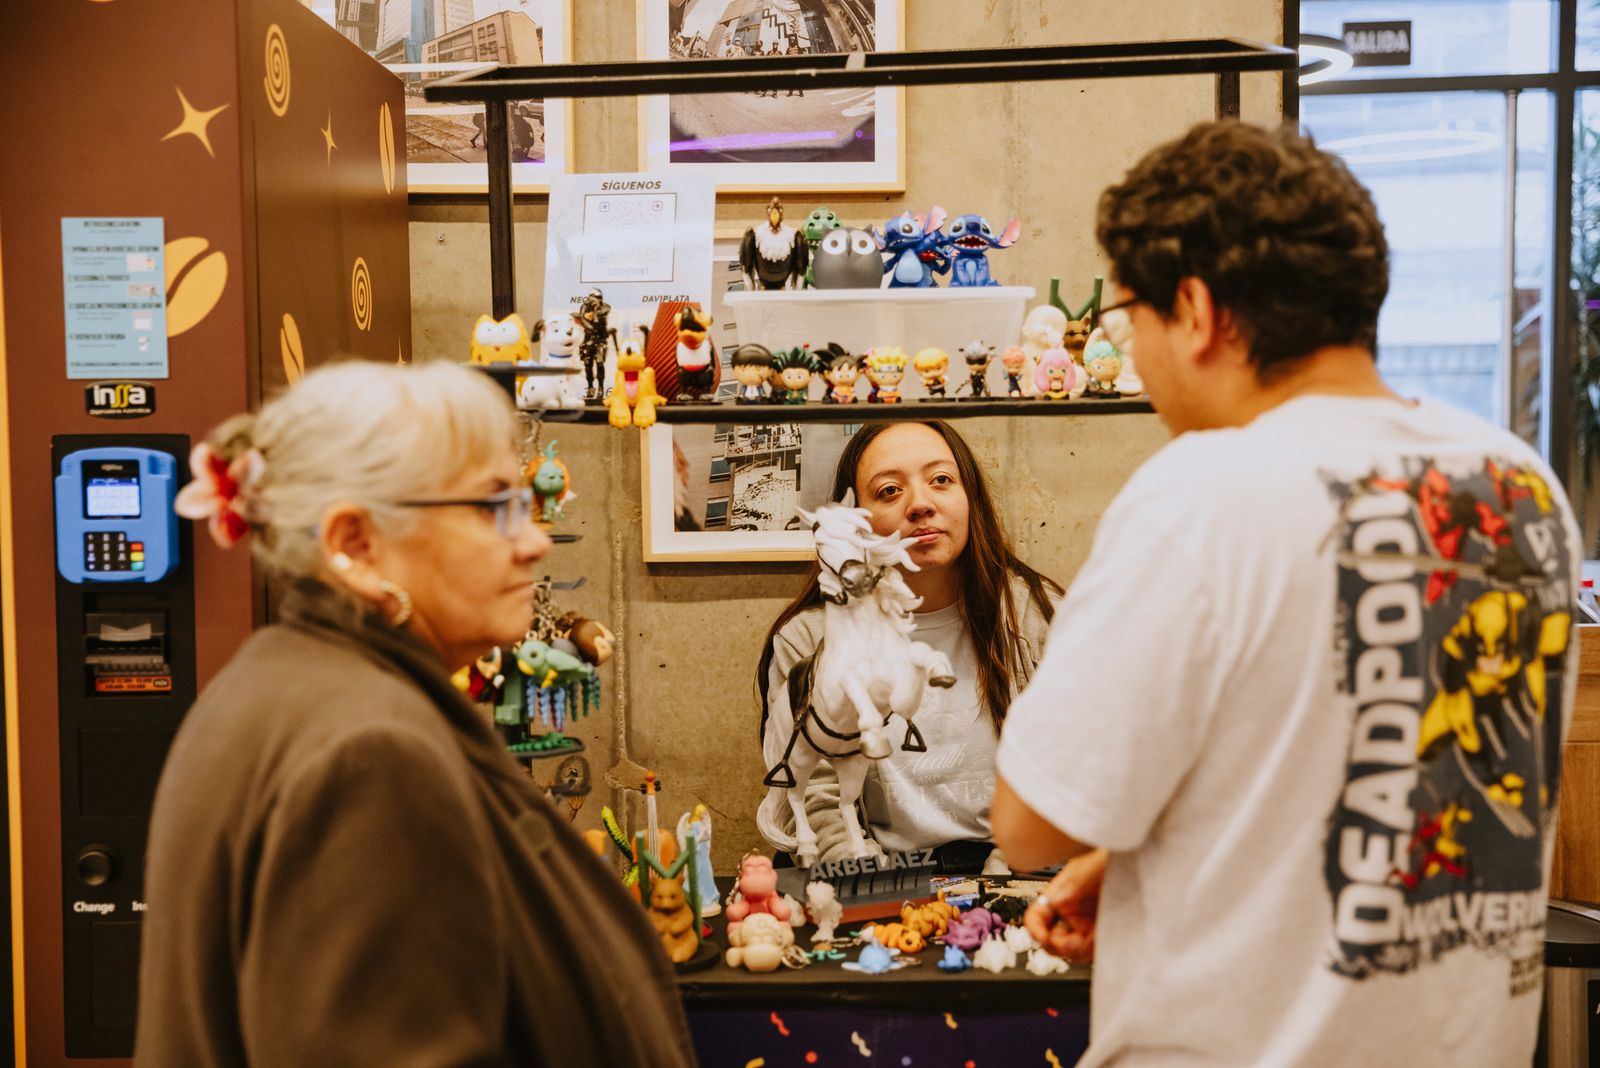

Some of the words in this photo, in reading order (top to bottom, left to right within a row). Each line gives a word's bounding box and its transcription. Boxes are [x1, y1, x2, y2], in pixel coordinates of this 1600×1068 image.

[1344, 29, 1410, 54] SALIDA
[601, 180, 662, 191] SÍGUENOS
[641, 295, 690, 304] DAVIPLATA
[1335, 491, 1425, 943] DEADPOOL
[809, 848, 938, 881] ARBELAEZ
[73, 901, 116, 915] Change
